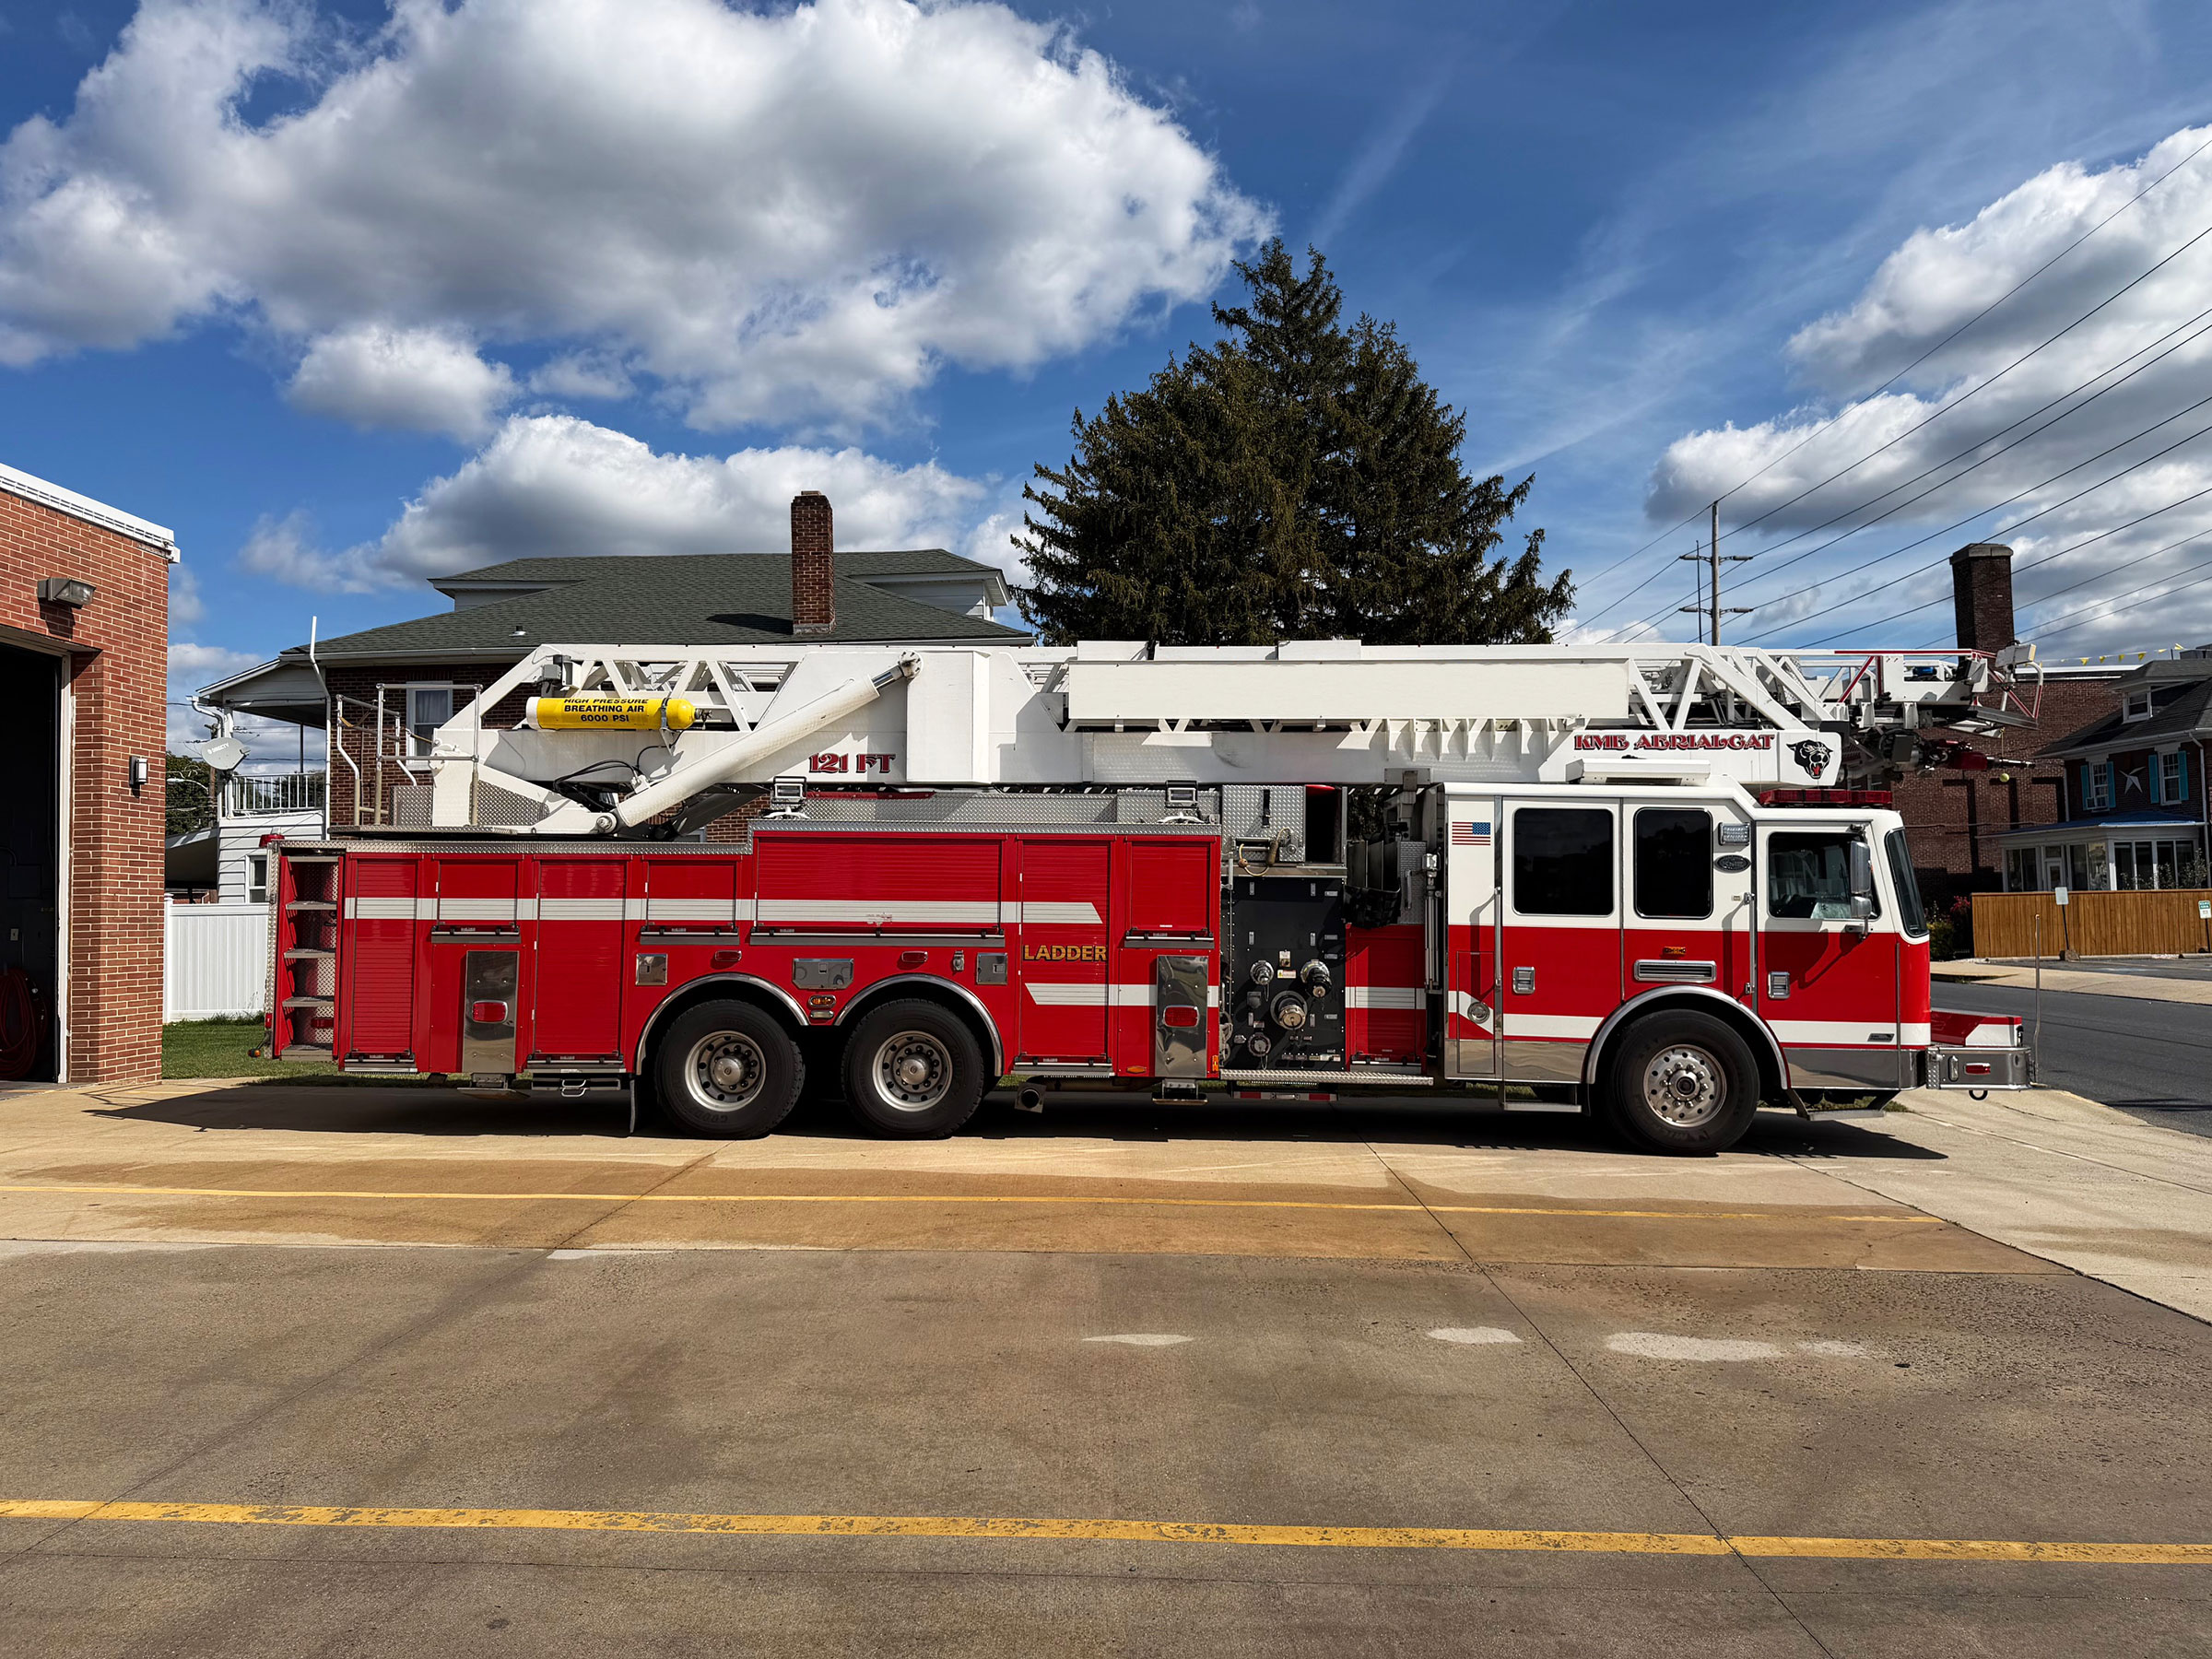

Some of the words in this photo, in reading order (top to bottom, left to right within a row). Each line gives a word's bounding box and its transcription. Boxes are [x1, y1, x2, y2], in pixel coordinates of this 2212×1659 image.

[1574, 735, 1630, 750] KME
[1633, 734, 1775, 750] AERIALCAT
[809, 753, 848, 773] 121
[855, 754, 896, 773] FT
[1023, 945, 1107, 961] LADDER
